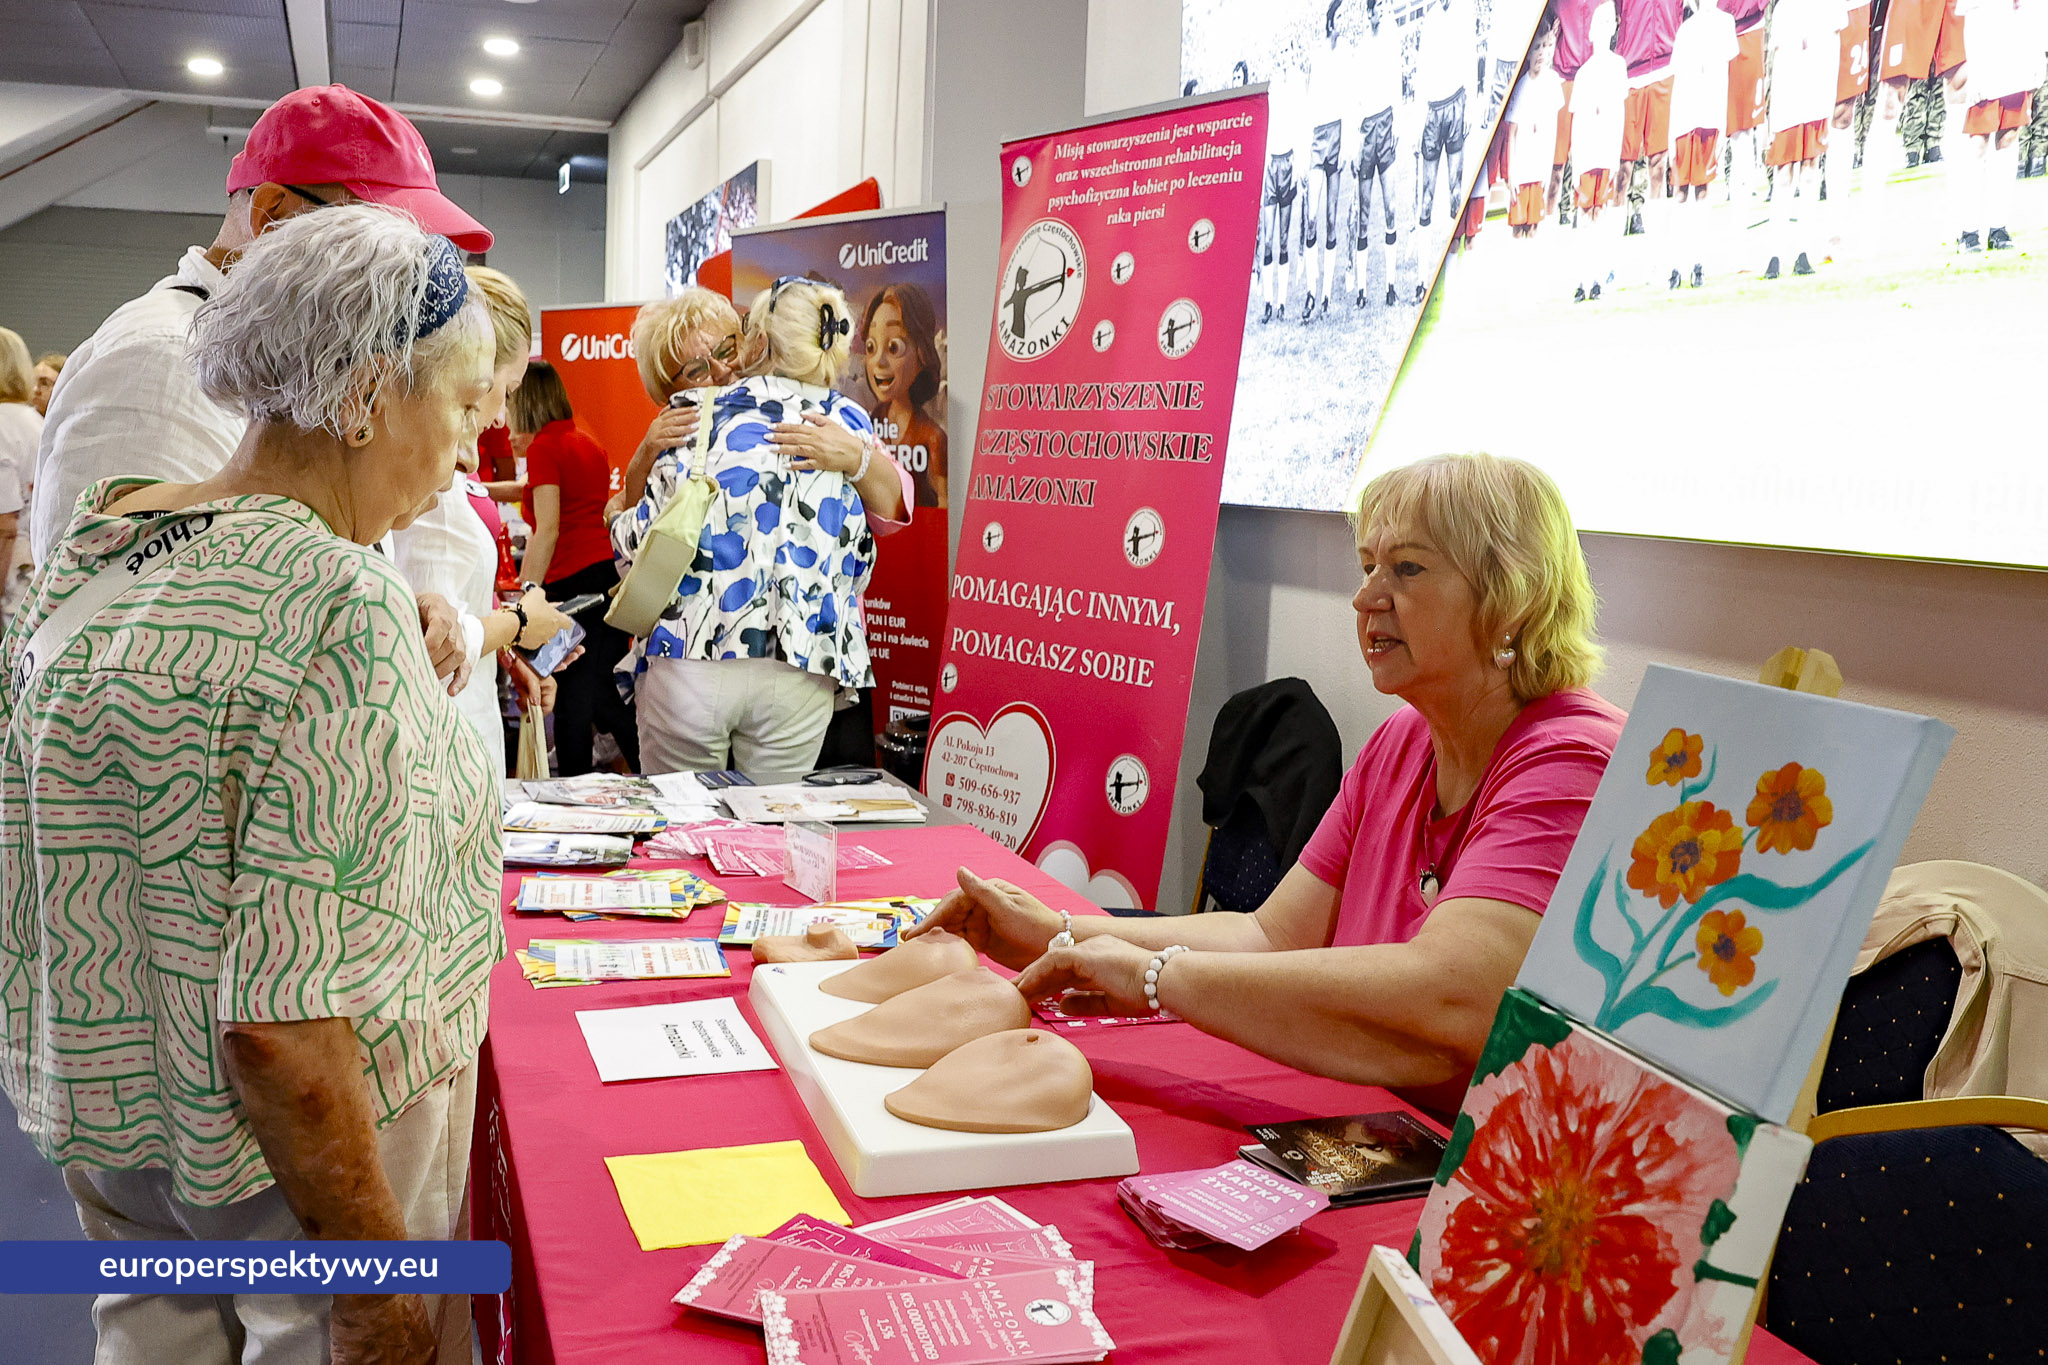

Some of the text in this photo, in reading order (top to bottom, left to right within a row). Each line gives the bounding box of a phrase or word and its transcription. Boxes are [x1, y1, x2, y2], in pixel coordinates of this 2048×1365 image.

[1054, 112, 1253, 160] Misją stowarzyszenia jest wsparcie
[1055, 141, 1242, 183] oraz wszechstronna rehabilitacja
[1047, 167, 1243, 212] psychofizyczna kobiet po leczeniu
[1106, 203, 1166, 227] raka piersi
[857, 237, 928, 265] UniCredit
[1042, 223, 1083, 279] Częstochowskie
[581, 332, 635, 361] UniCre
[999, 316, 1071, 355] AMAZONKI
[1160, 339, 1194, 356] AMAZONKI
[985, 382, 1205, 411] STOWARZYSZENIE
[873, 417, 899, 440] bie
[978, 430, 1214, 464] CZĘSTOCHOWSKIE
[970, 473, 1097, 508] AMAZONKI
[126, 513, 214, 575] Chloé
[1126, 547, 1158, 565] AMAZONKI
[864, 598, 892, 610] unków
[951, 573, 1182, 636] POMAGAJĄC INNYM,
[866, 613, 883, 626] PLN
[888, 616, 907, 629] EUR
[878, 647, 891, 660] UE
[888, 634, 899, 644] na
[950, 627, 1155, 689] POMAGASZ SOBIE
[944, 736, 996, 757] Al. Pokoju 13
[941, 752, 1019, 781] 42-207 Częstochowa
[958, 776, 1021, 806] 509-656-937
[1108, 792, 1142, 813] AMAZONKI
[956, 797, 1018, 827] 798-836-819
[661, 1023, 698, 1059] Amazonki
[715, 1018, 749, 1056] Stowarzyszenie
[1200, 1176, 1251, 1203] ŻYCIA
[1216, 1170, 1282, 1205] KARTKA
[1232, 1163, 1307, 1201] RÓŻOWA
[900, 1292, 913, 1309] KRS
[877, 1318, 896, 1340] 1,5%
[984, 1280, 1034, 1356] AMAZONKI
